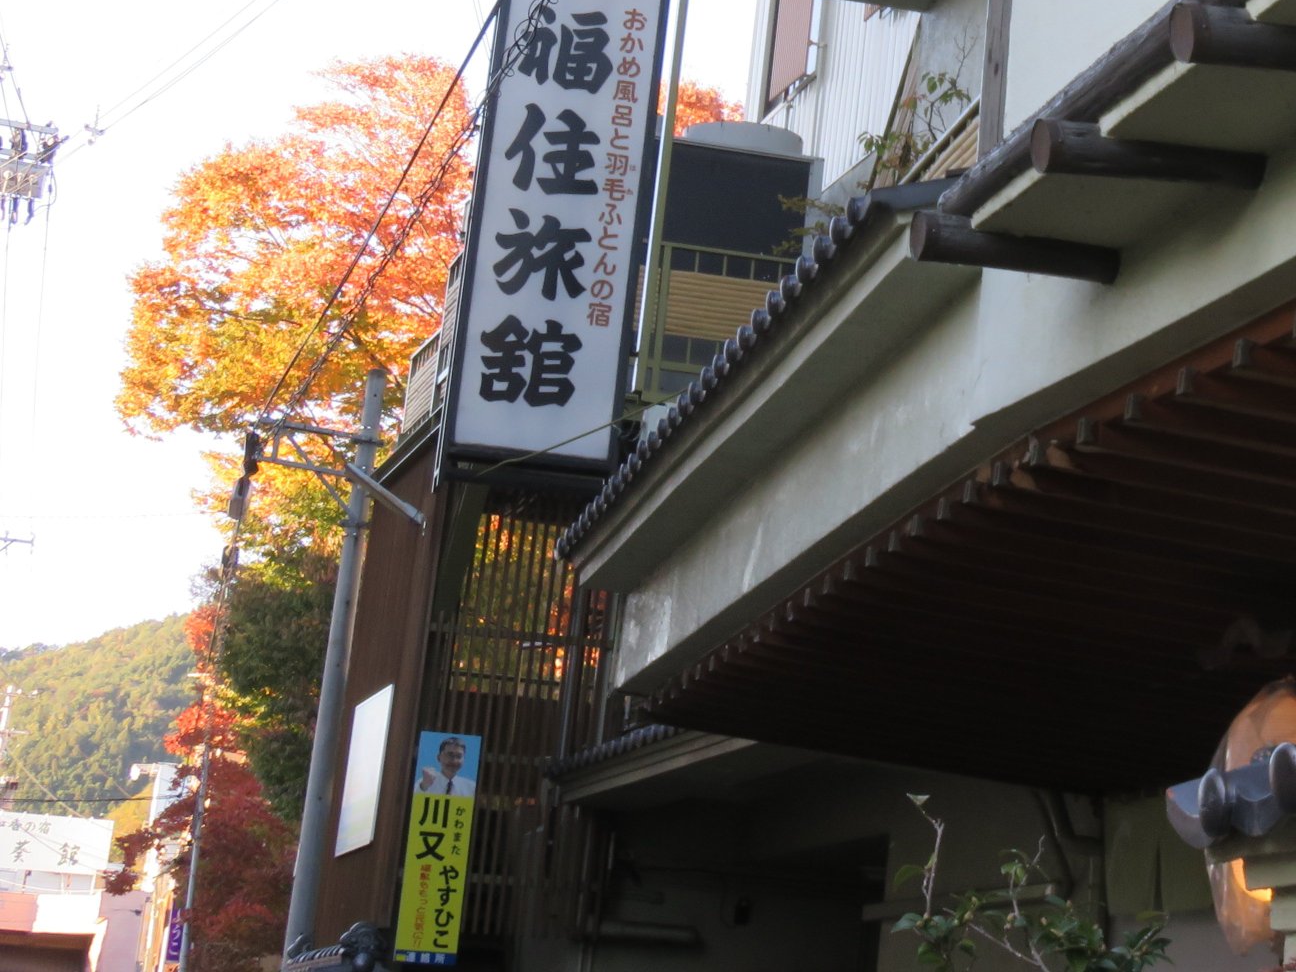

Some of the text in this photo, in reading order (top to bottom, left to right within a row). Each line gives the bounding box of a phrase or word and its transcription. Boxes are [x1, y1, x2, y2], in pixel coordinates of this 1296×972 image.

[586, 8, 648, 327] おかめ風呂と羽毛ふとんの宿
[416, 796, 451, 861] 川又
[451, 805, 466, 856] かわまた
[432, 865, 460, 949] やすひこ
